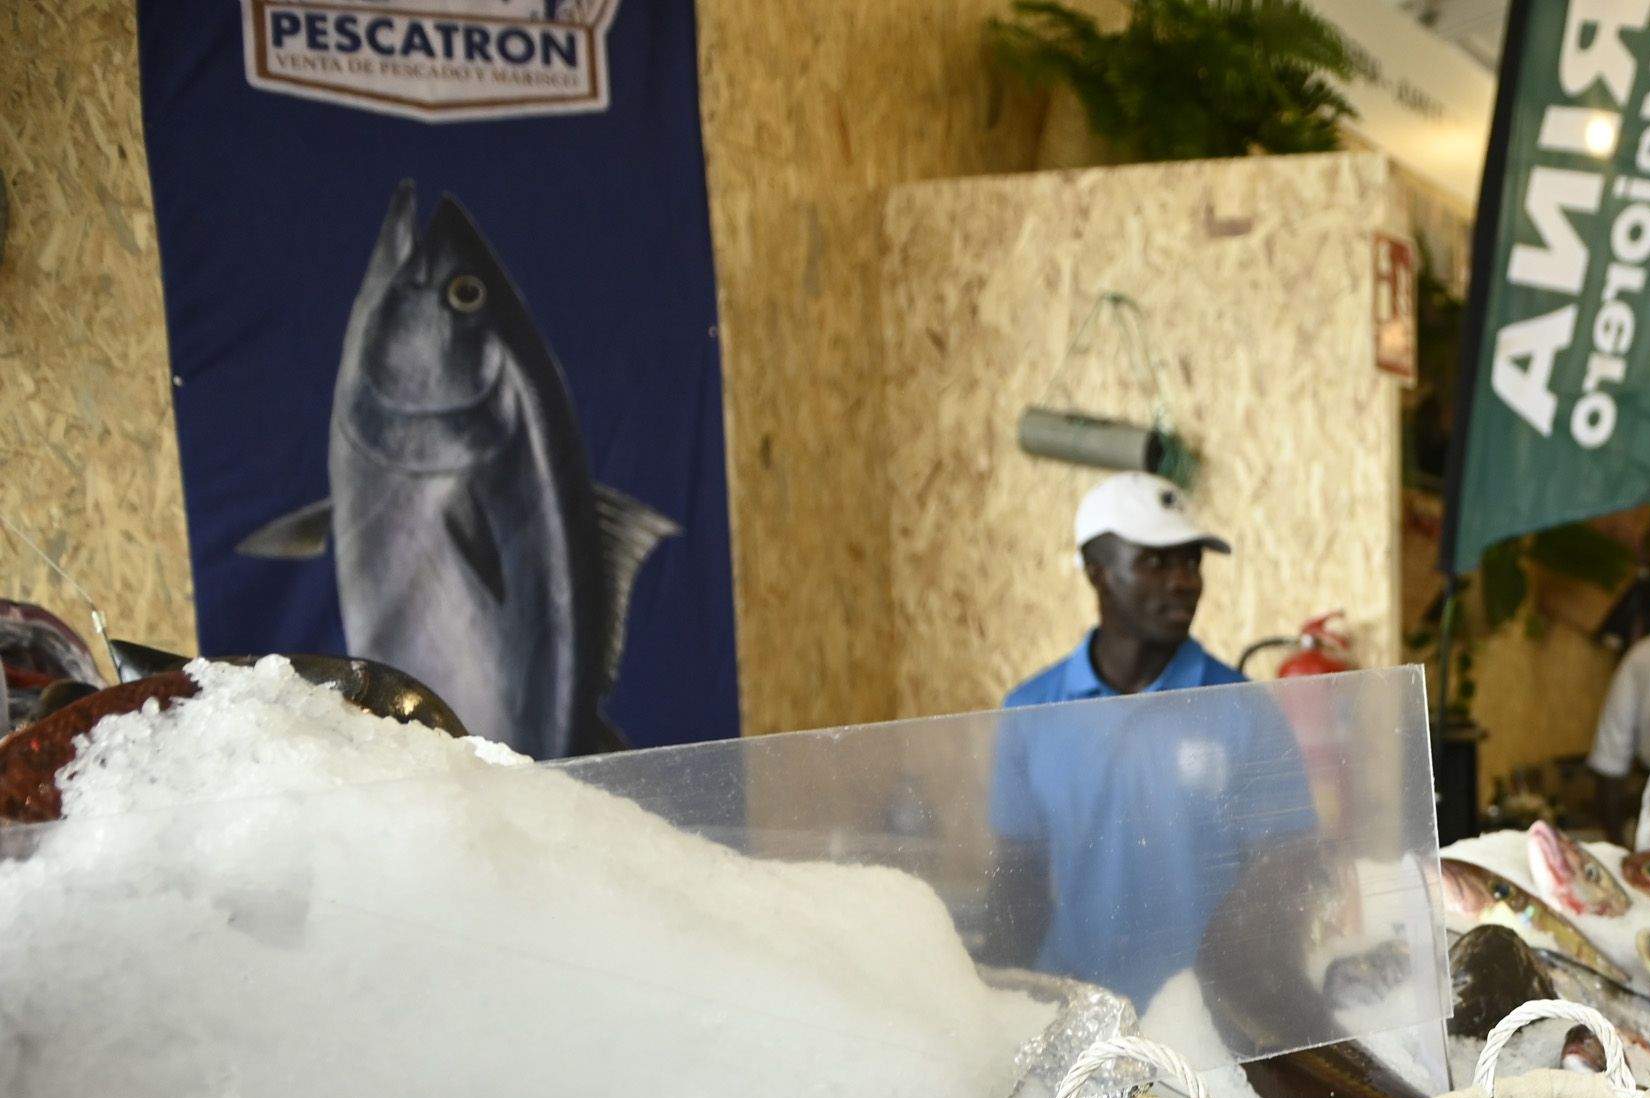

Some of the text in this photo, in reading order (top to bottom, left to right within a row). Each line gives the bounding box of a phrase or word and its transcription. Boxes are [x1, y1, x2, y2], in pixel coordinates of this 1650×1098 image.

[271, 11, 578, 68] PESCATRON
[276, 53, 343, 74] VENTA
[349, 57, 375, 75] DE
[379, 60, 472, 81] PESCADO
